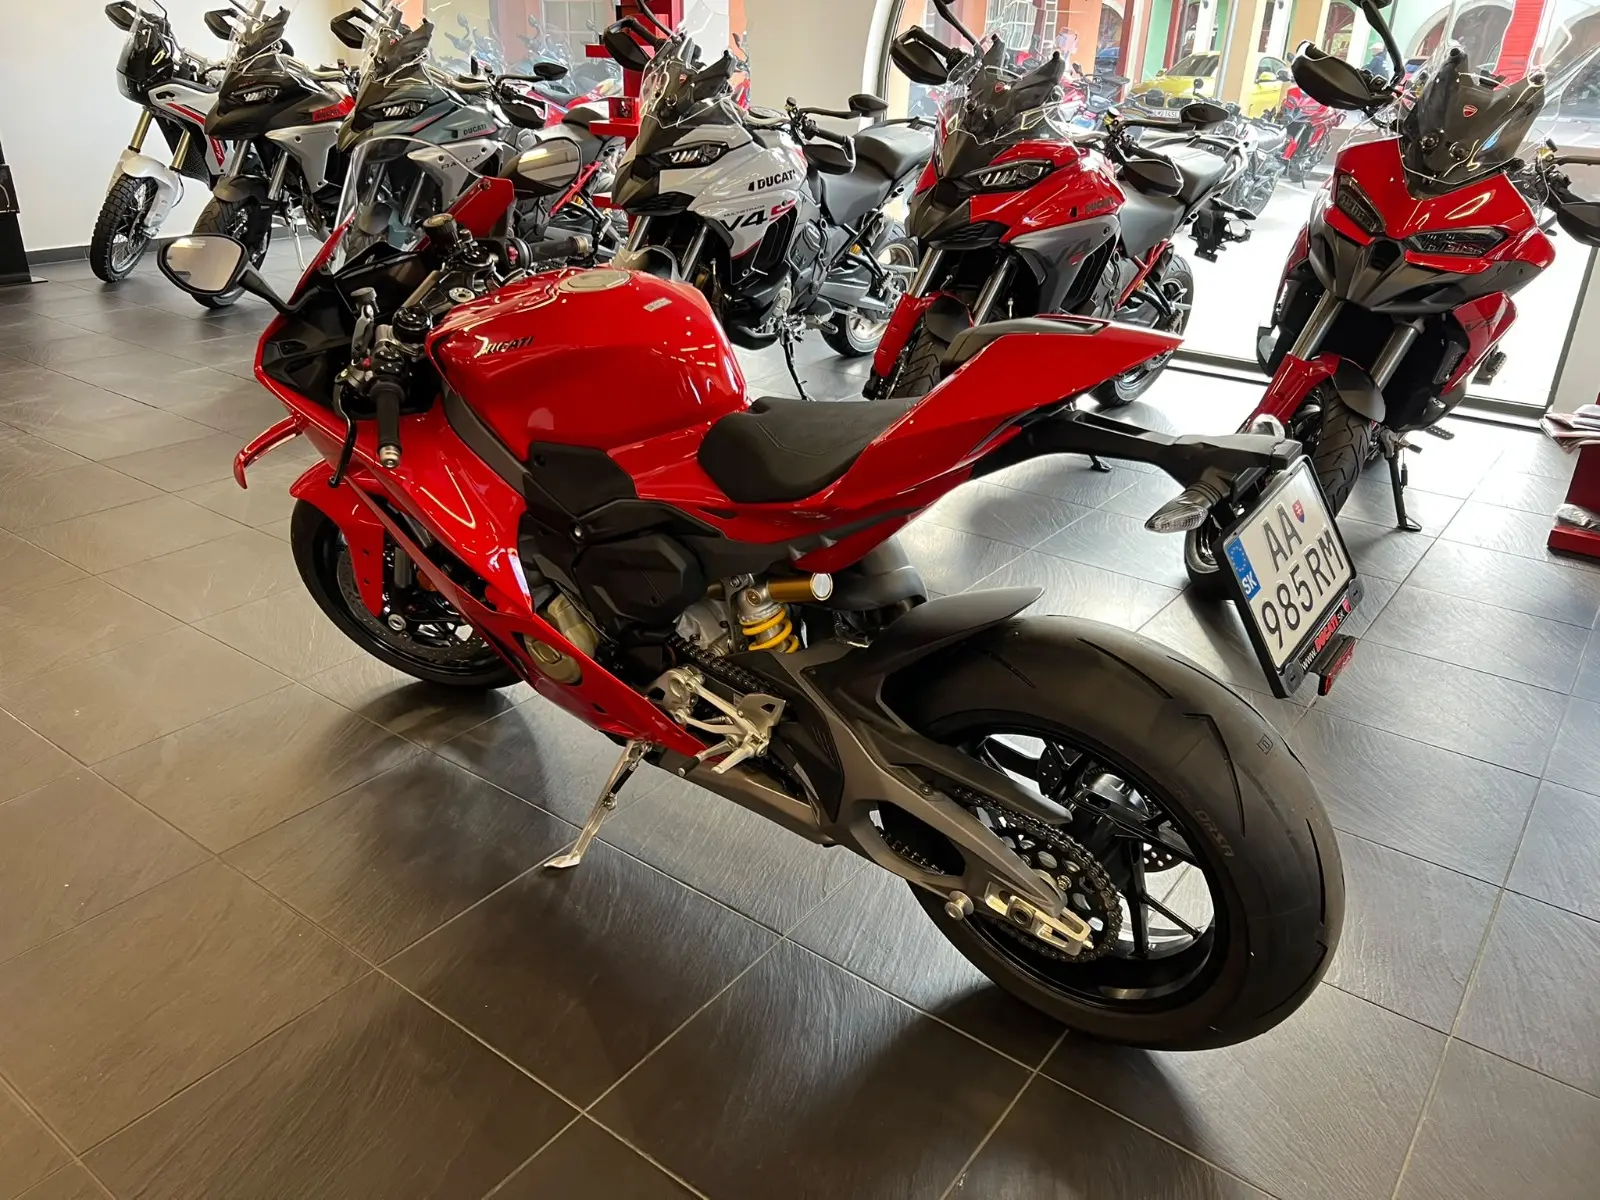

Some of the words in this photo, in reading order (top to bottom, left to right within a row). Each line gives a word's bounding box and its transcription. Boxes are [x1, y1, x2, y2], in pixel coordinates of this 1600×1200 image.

[463, 124, 487, 136] DUCATI
[441, 155, 480, 170] RALY
[474, 334, 534, 359] DUCATI
[1261, 503, 1303, 574] AA
[1241, 570, 1258, 595] SK
[1261, 526, 1345, 650] 985RM
